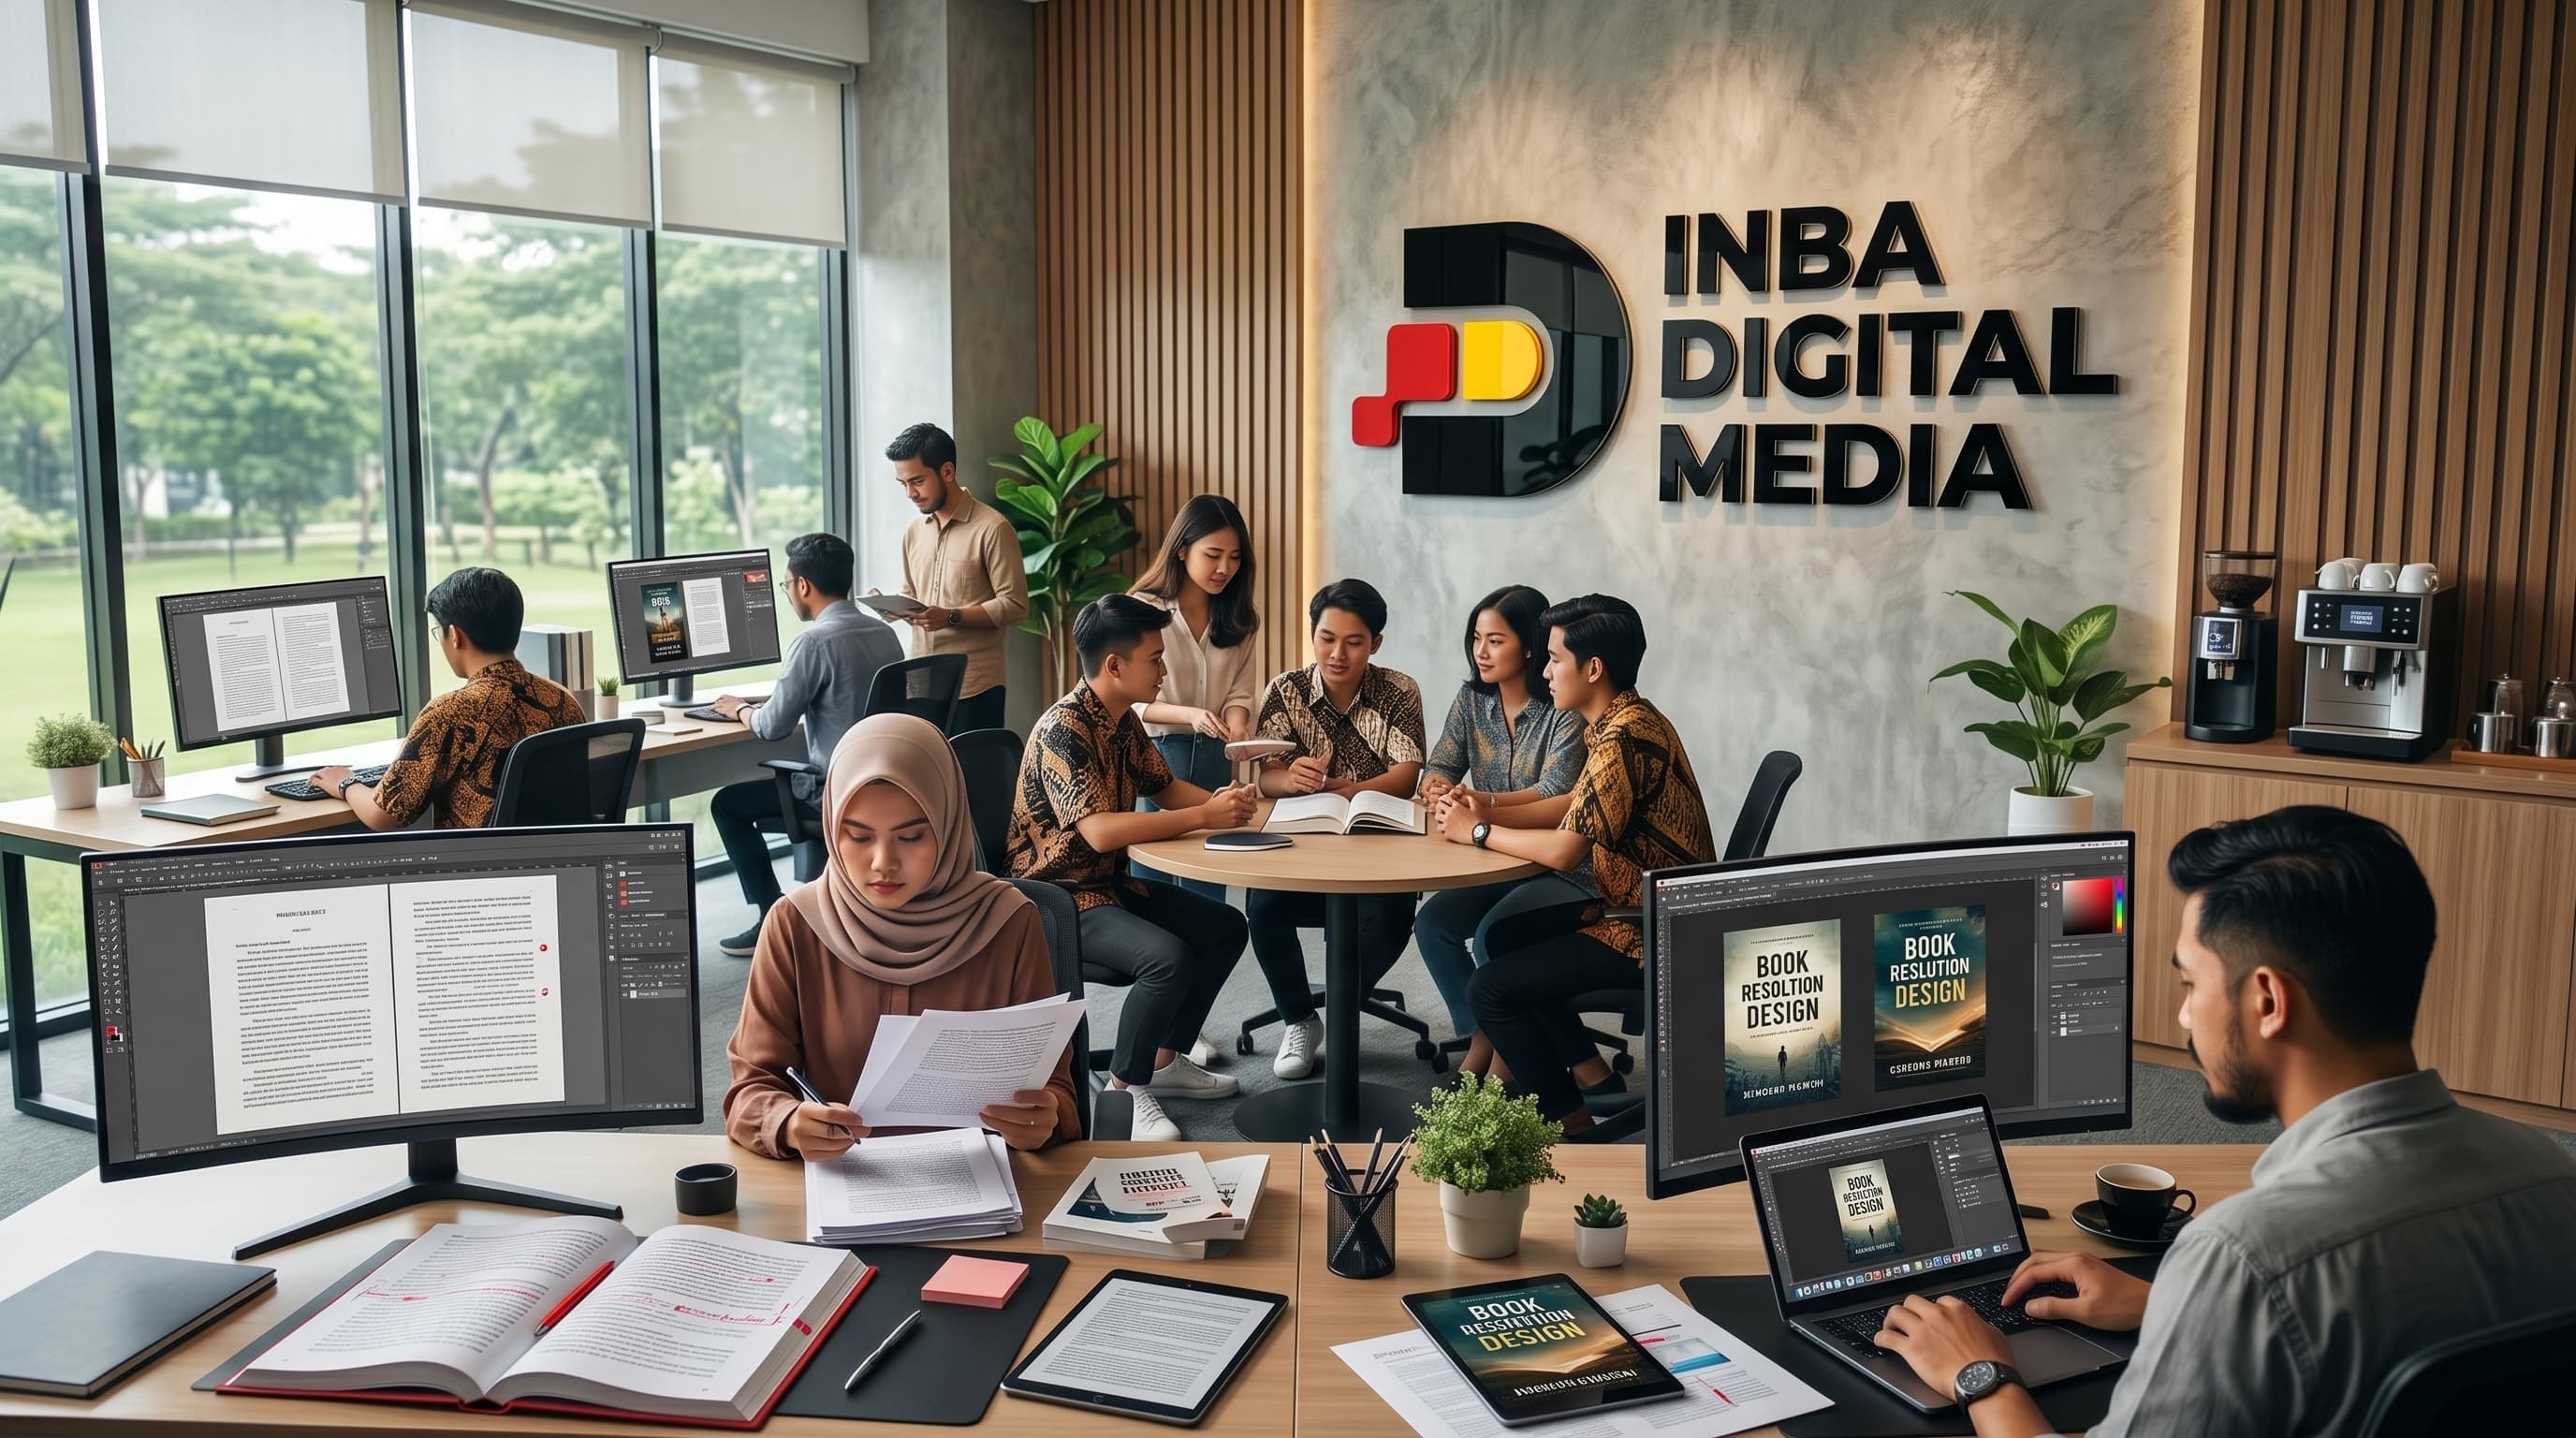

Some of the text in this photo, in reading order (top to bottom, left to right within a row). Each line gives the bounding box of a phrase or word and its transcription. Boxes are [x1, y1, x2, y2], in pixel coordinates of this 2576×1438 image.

[1664, 200, 1946, 296] INBA
[1661, 306, 2119, 400] DIGITAL
[1658, 423, 2036, 510] MEDIA
[1905, 932, 1956, 961] BOOK
[1757, 949, 1809, 978] BOOK
[1890, 957, 1969, 982] RESLUTION
[1741, 975, 1823, 1003] RESOLTION
[1895, 977, 1966, 1008] DESIGN
[1747, 997, 1819, 1029] DESIGN
[1847, 1174, 1875, 1191] BOOK
[1847, 1197, 1884, 1217] DESIGN
[1468, 1297, 1545, 1321] BOOK
[1477, 1321, 1588, 1352] DESIGN
